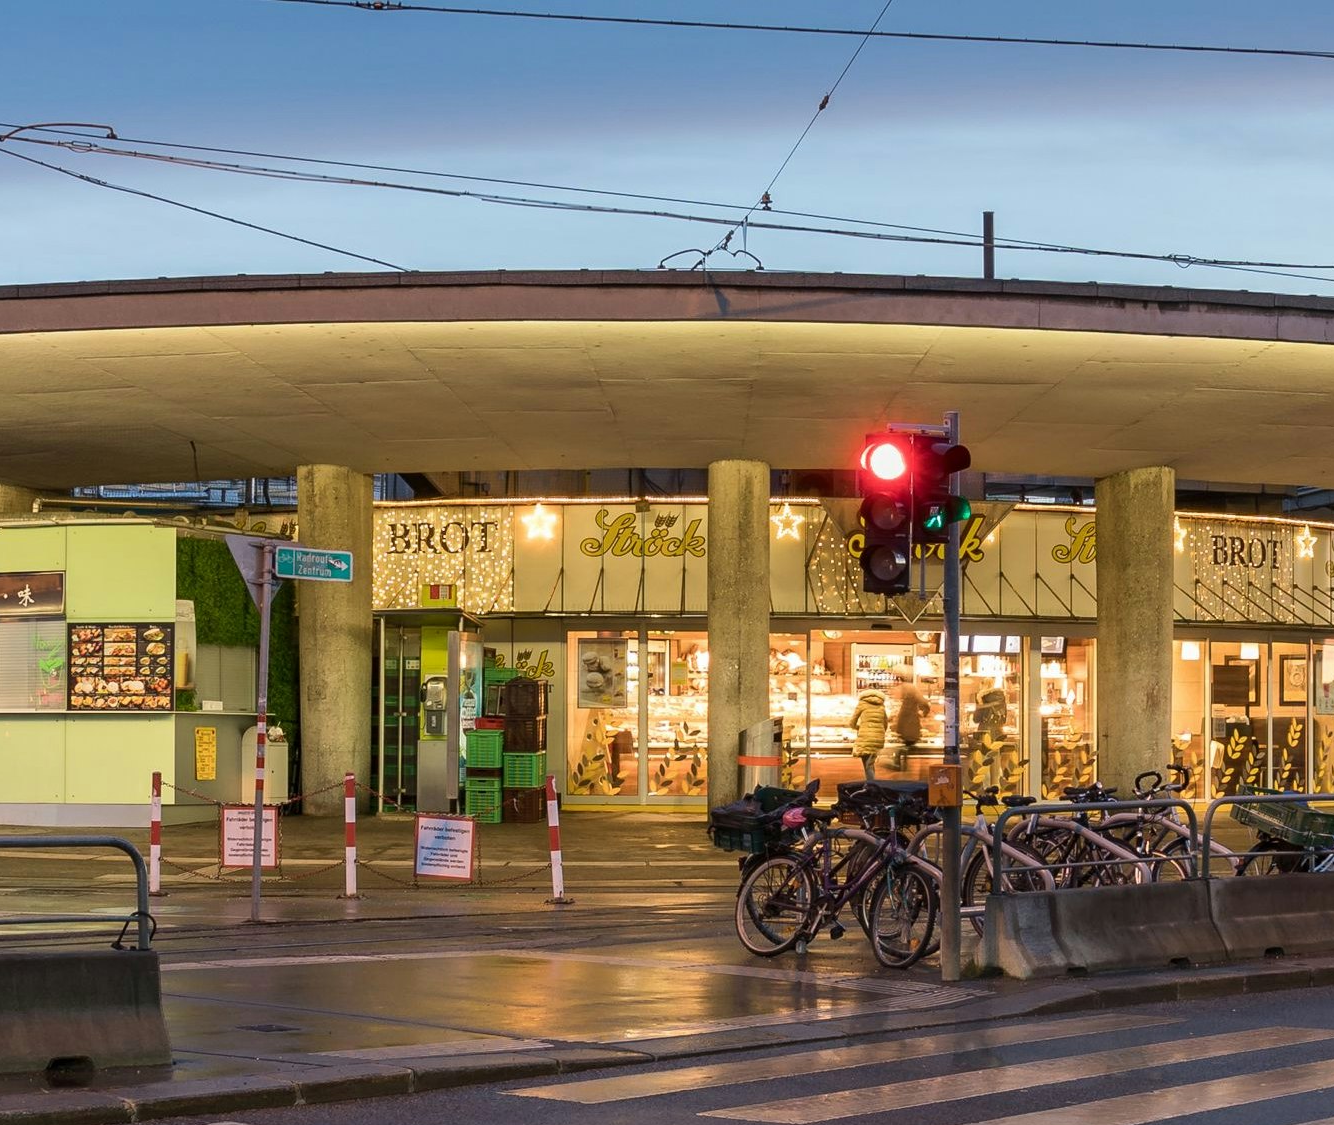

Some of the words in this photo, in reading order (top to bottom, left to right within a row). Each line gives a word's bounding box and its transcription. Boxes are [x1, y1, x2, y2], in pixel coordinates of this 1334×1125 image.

[387, 521, 498, 554] BROT
[580, 509, 706, 557] Ströck
[1210, 535, 1283, 569] BROT
[298, 565, 332, 577] Zentrum
